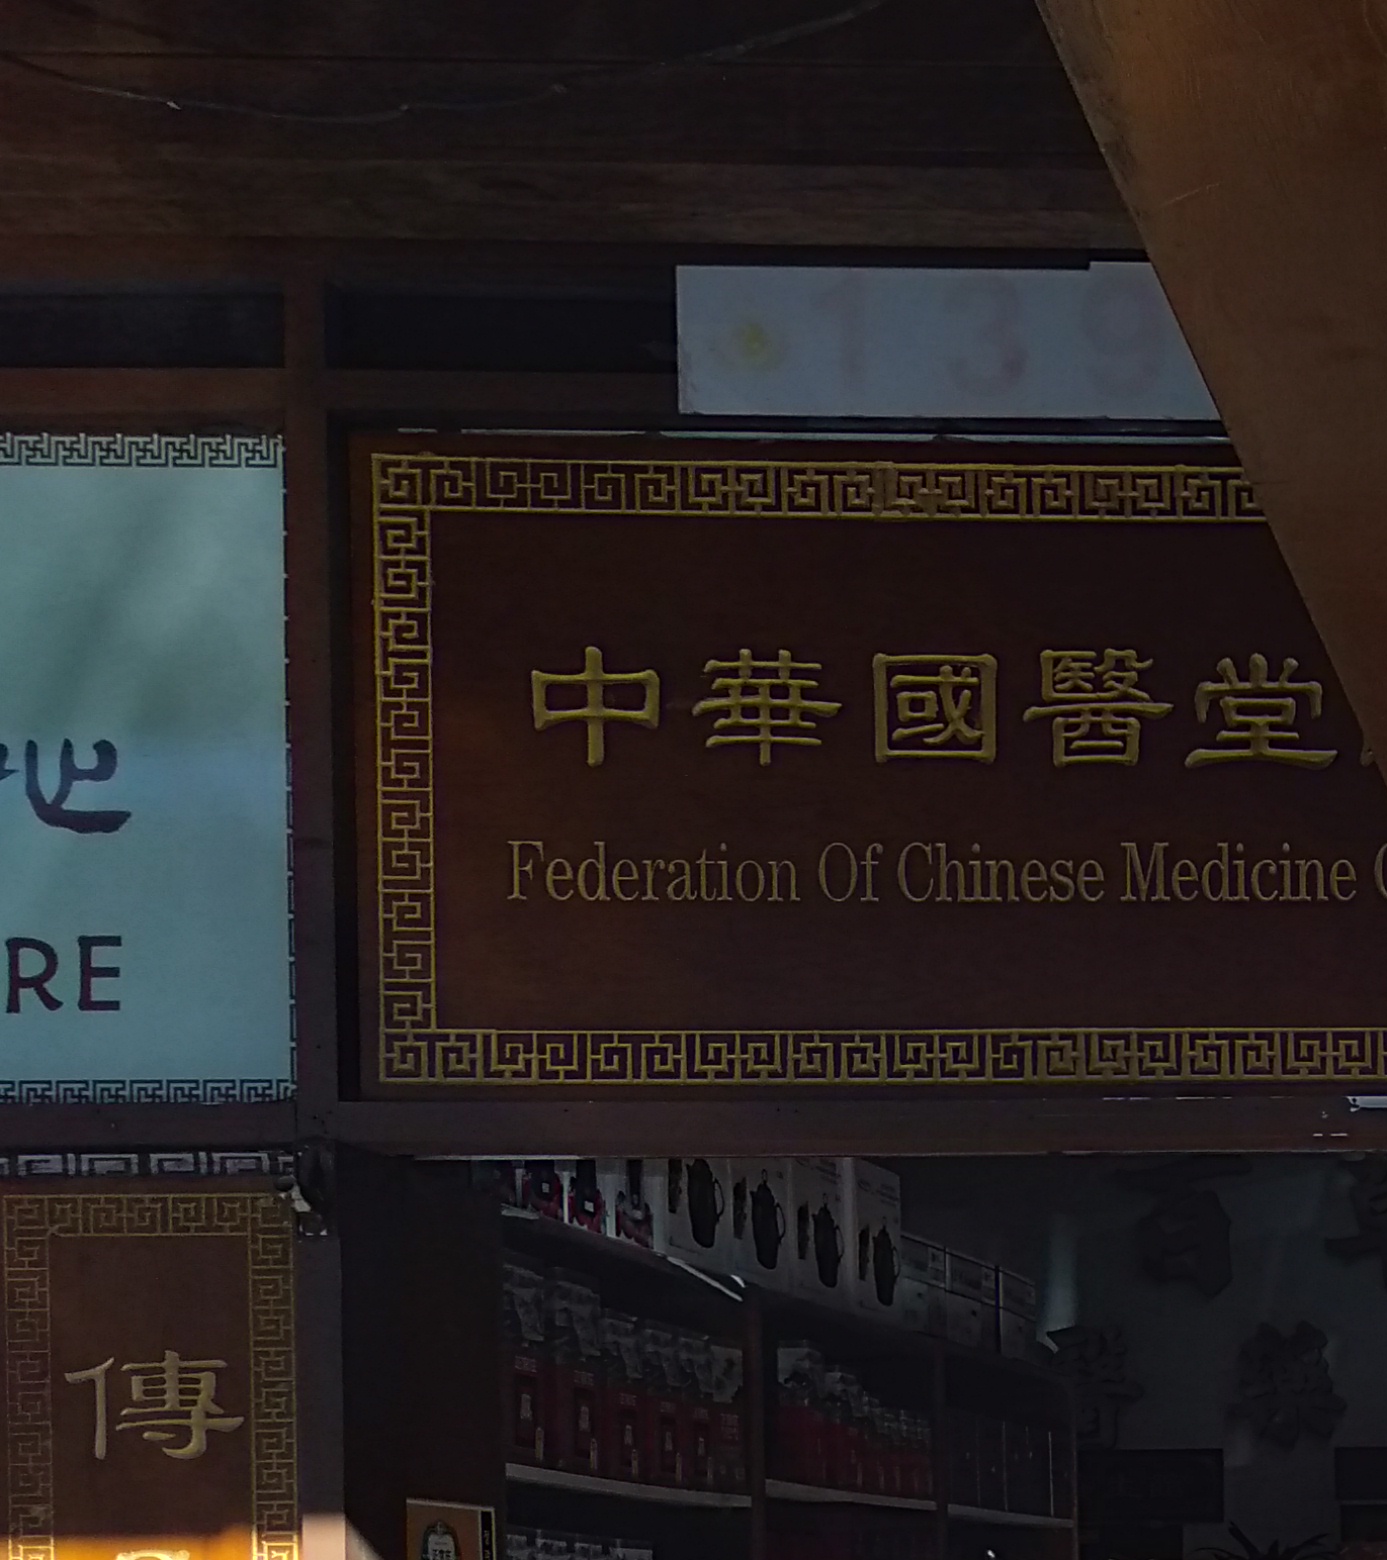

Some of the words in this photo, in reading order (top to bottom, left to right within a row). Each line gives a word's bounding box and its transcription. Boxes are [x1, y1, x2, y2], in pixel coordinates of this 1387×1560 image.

[531, 645, 1338, 770] 中華國醫堂
[506, 839, 803, 906] Federation
[819, 839, 884, 906] Of
[896, 840, 1106, 906] Chinese
[1119, 840, 1359, 905] Medicine
